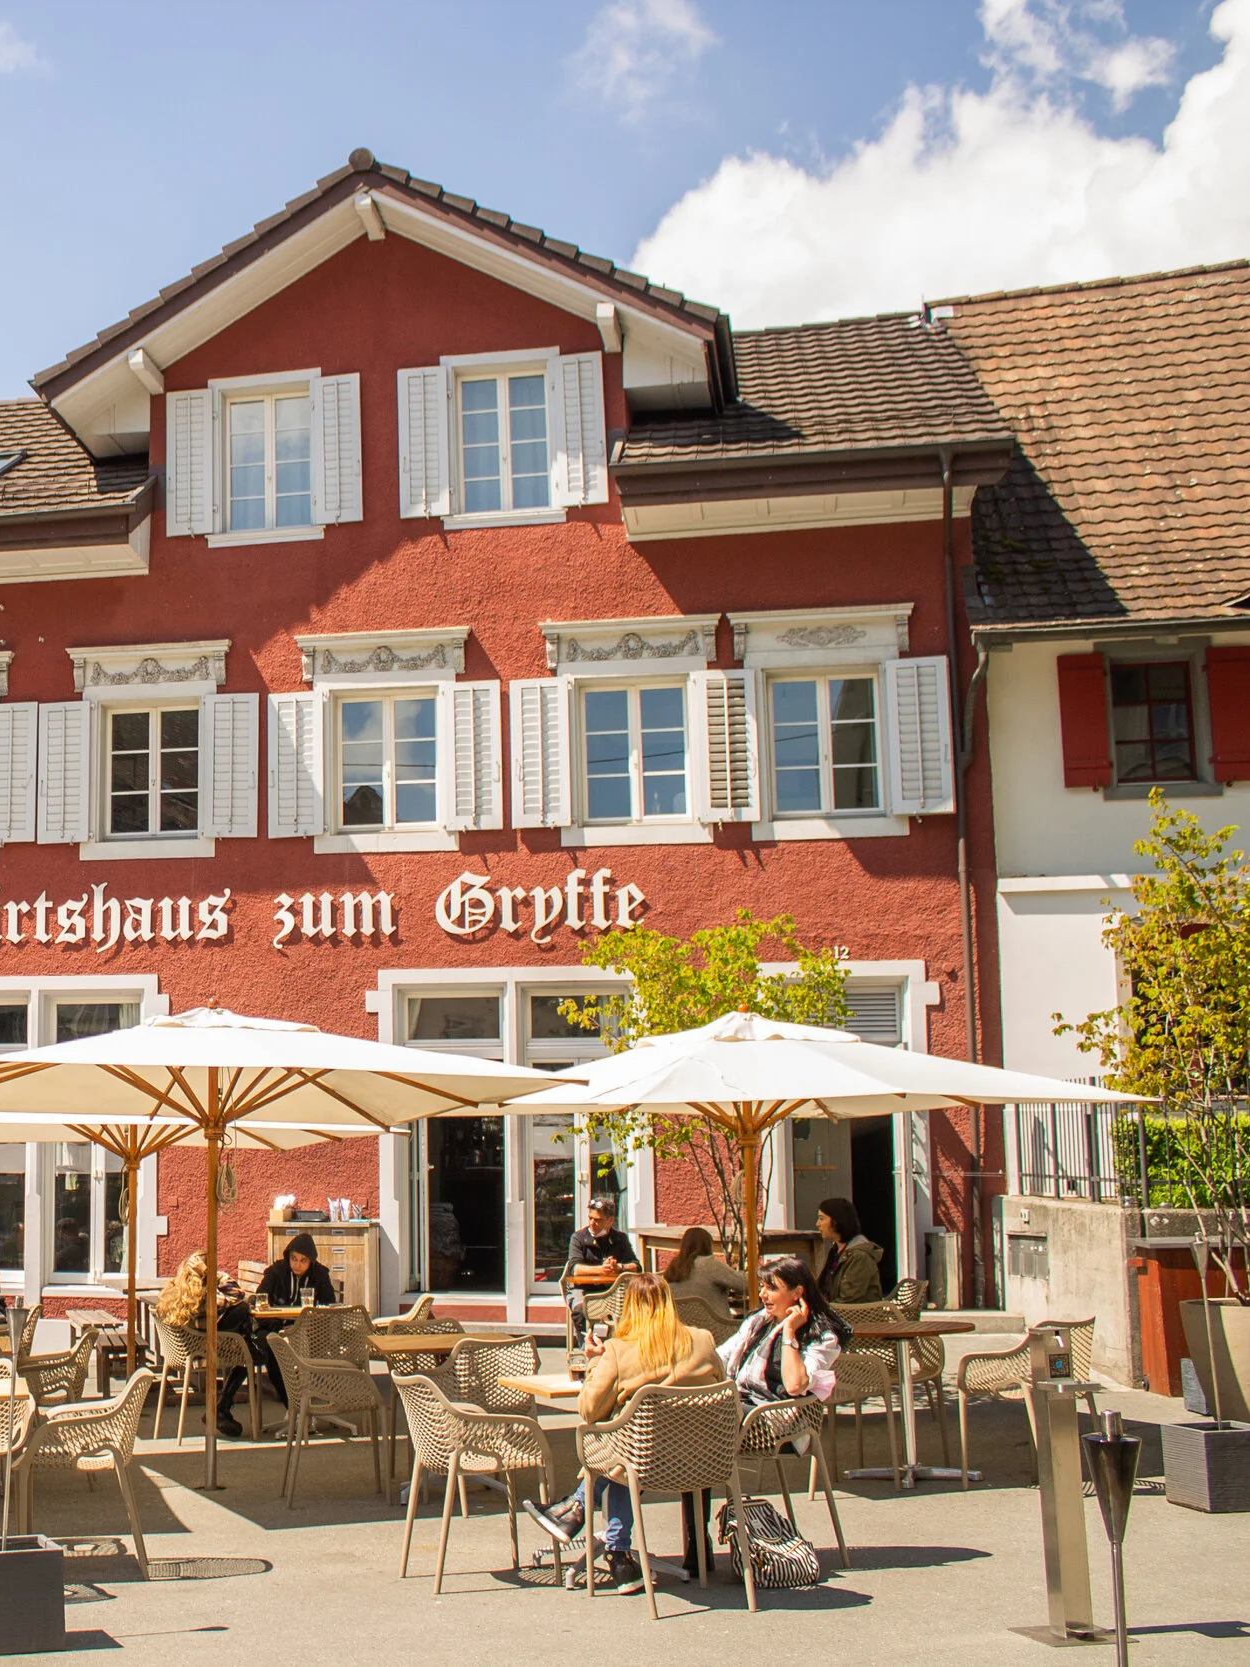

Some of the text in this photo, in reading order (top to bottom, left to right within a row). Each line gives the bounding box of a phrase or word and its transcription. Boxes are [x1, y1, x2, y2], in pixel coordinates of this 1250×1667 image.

[273, 890, 397, 949] zum
[435, 867, 646, 944] Gryffe
[833, 945, 850, 960] 12
